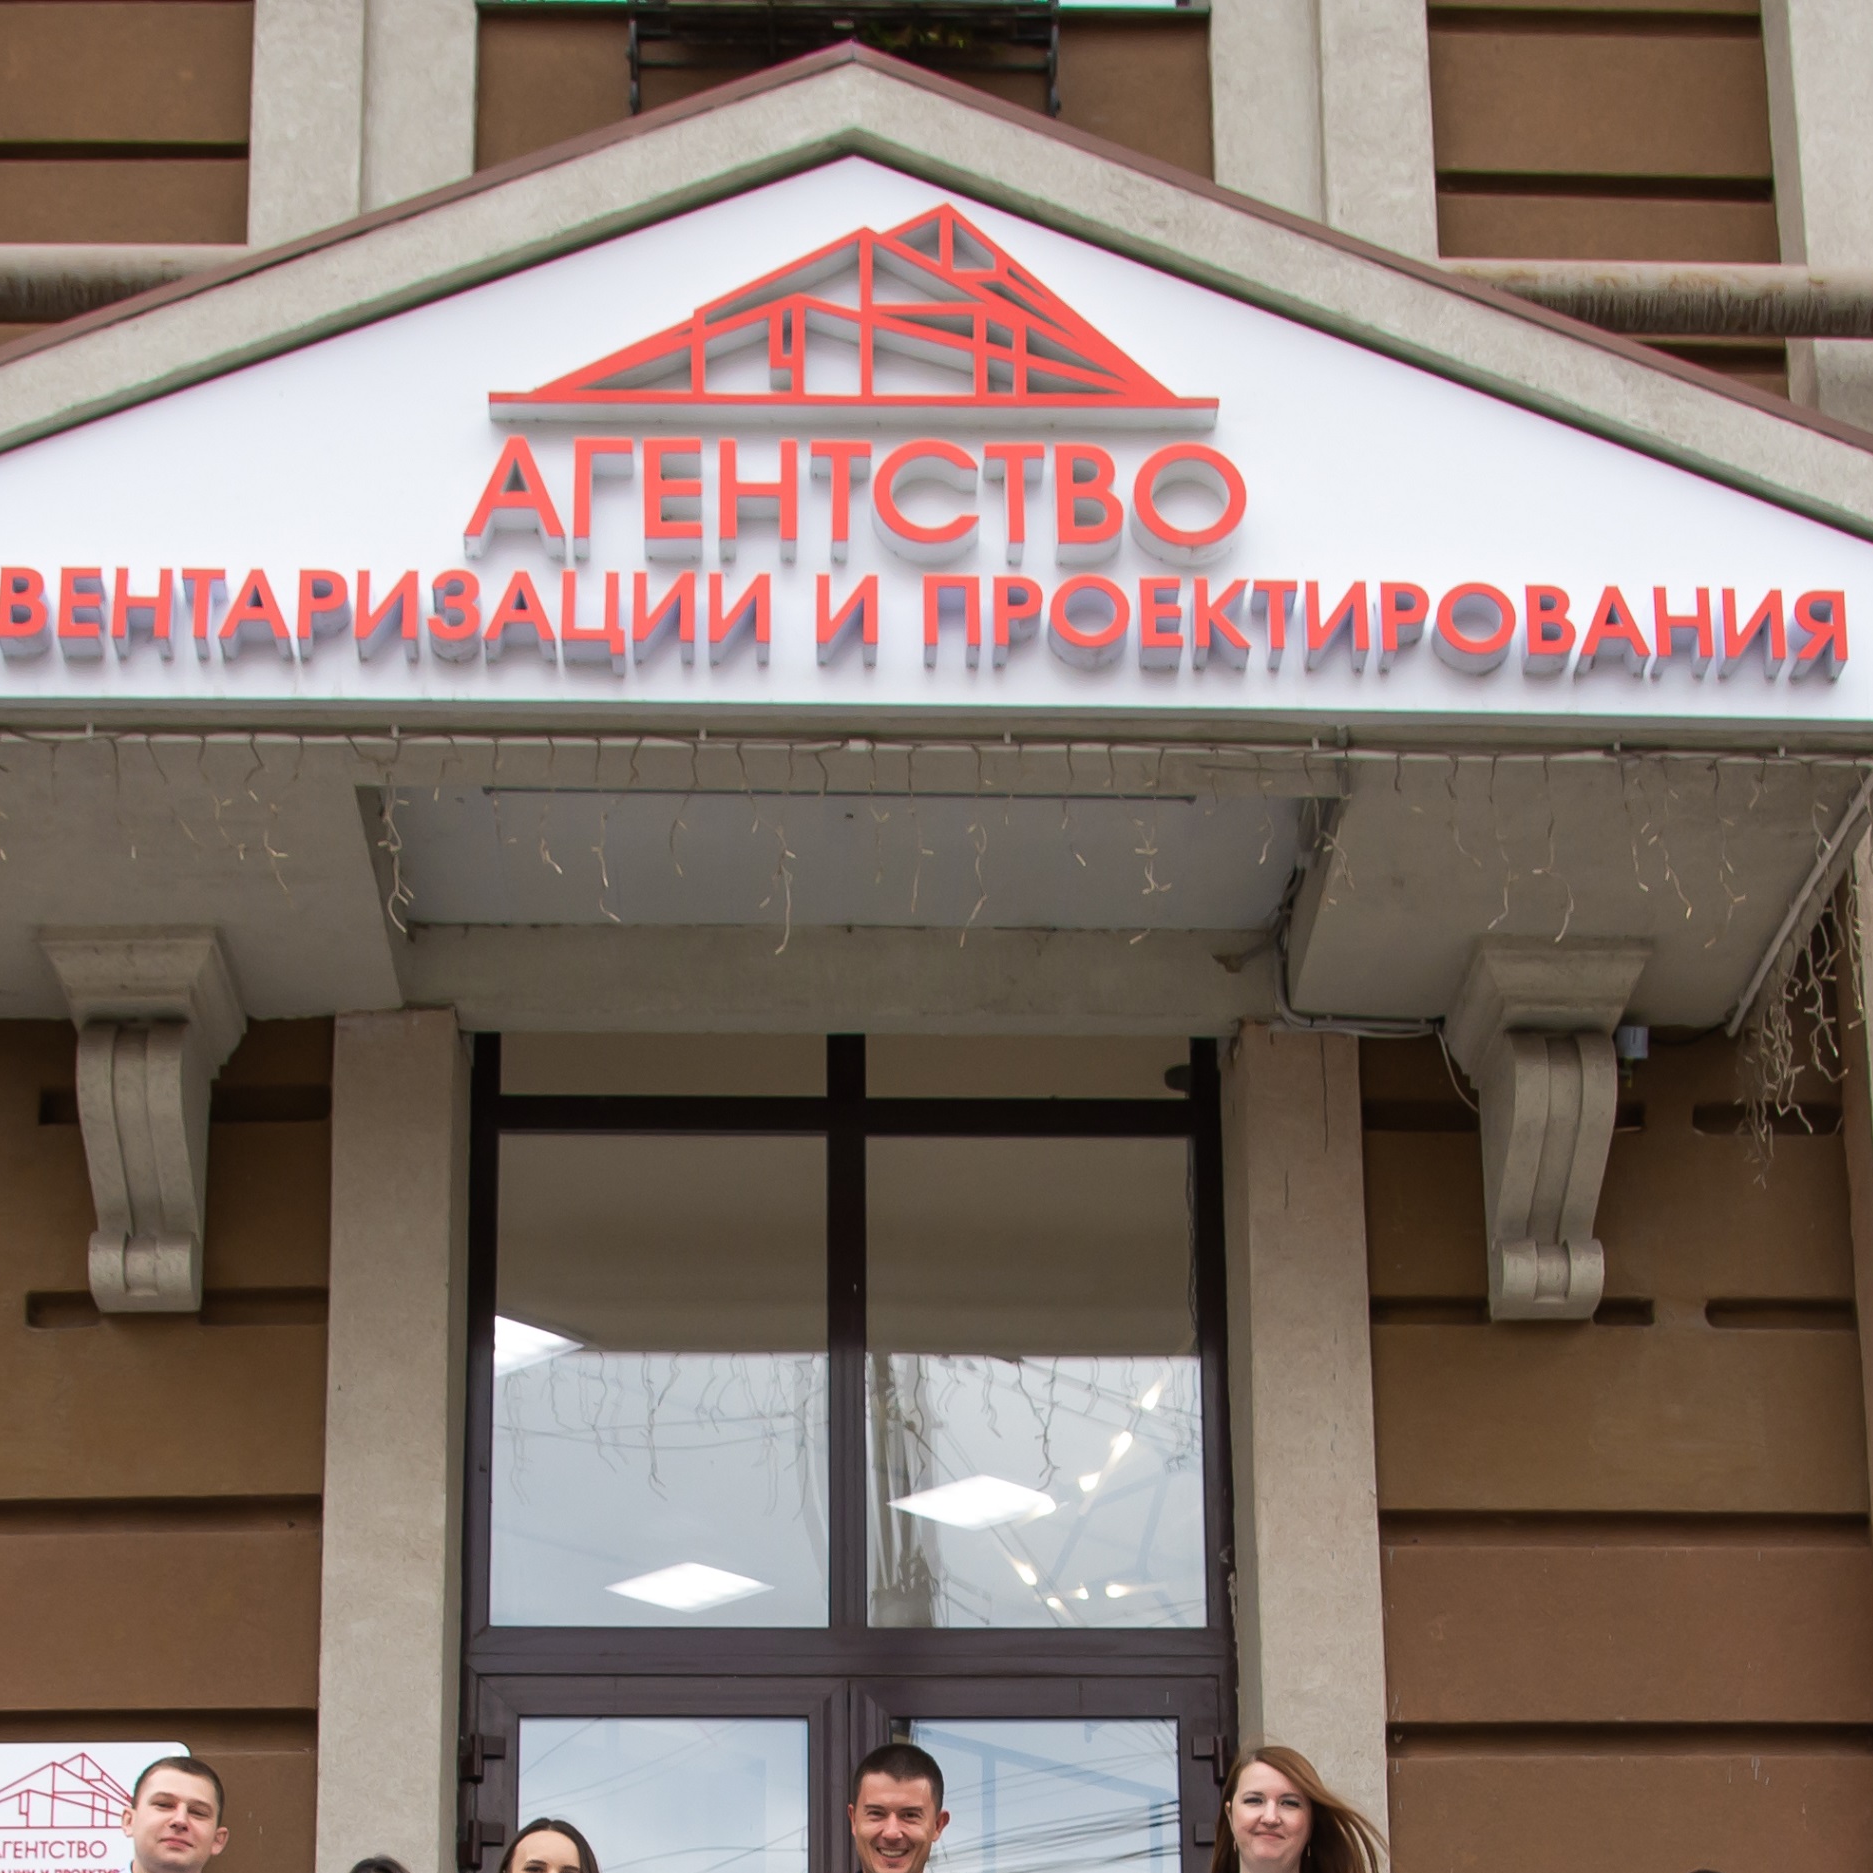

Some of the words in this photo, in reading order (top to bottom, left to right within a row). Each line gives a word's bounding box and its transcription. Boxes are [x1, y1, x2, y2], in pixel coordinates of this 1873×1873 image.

[464, 434, 1248, 549] АГЕНТСТВО
[814, 572, 880, 647] И
[921, 572, 1849, 664] ПРОЕКТИРОВАНИЯ
